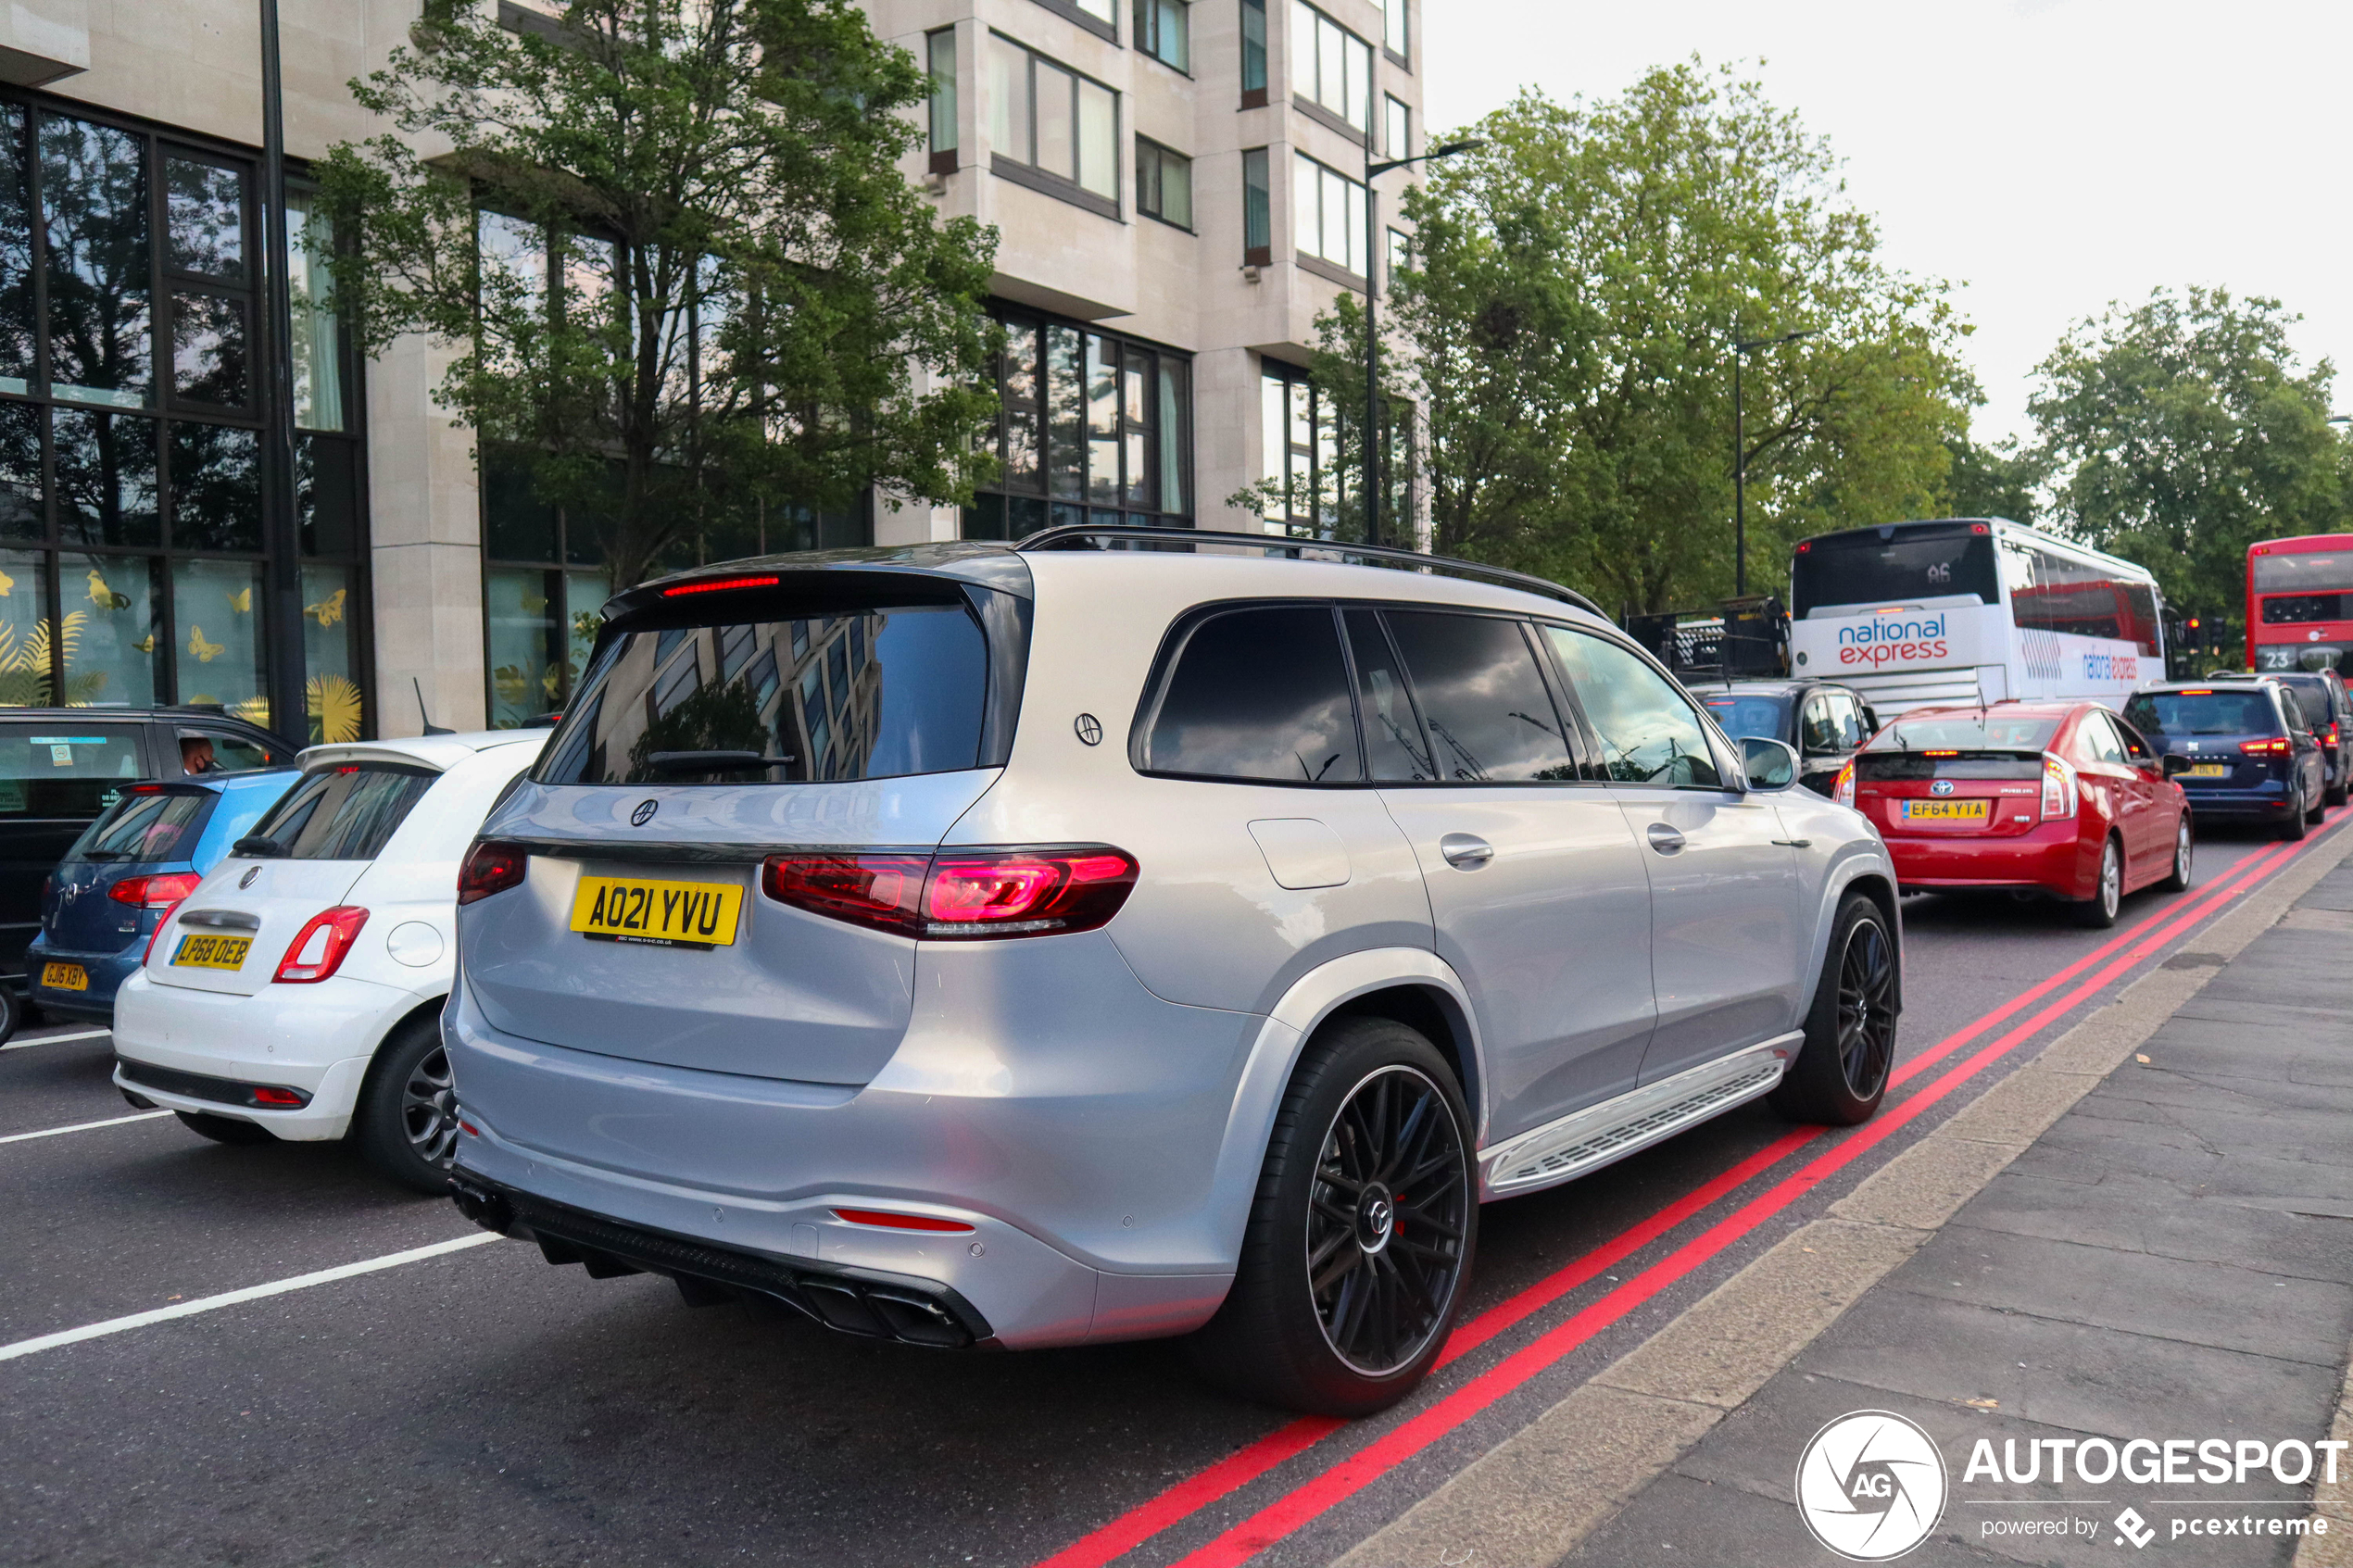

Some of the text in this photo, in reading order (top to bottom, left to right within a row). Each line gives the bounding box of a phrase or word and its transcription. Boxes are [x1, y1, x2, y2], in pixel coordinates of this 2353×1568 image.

[1839, 612, 1945, 644] national
[1840, 640, 1948, 669] express
[2083, 644, 2138, 689] national express
[2266, 651, 2289, 669] 23
[1912, 802, 1982, 816] EF64 YTA
[588, 885, 723, 936] AO21 YVU
[178, 937, 249, 965] LP68 OEB
[64, 966, 84, 986] XBY
